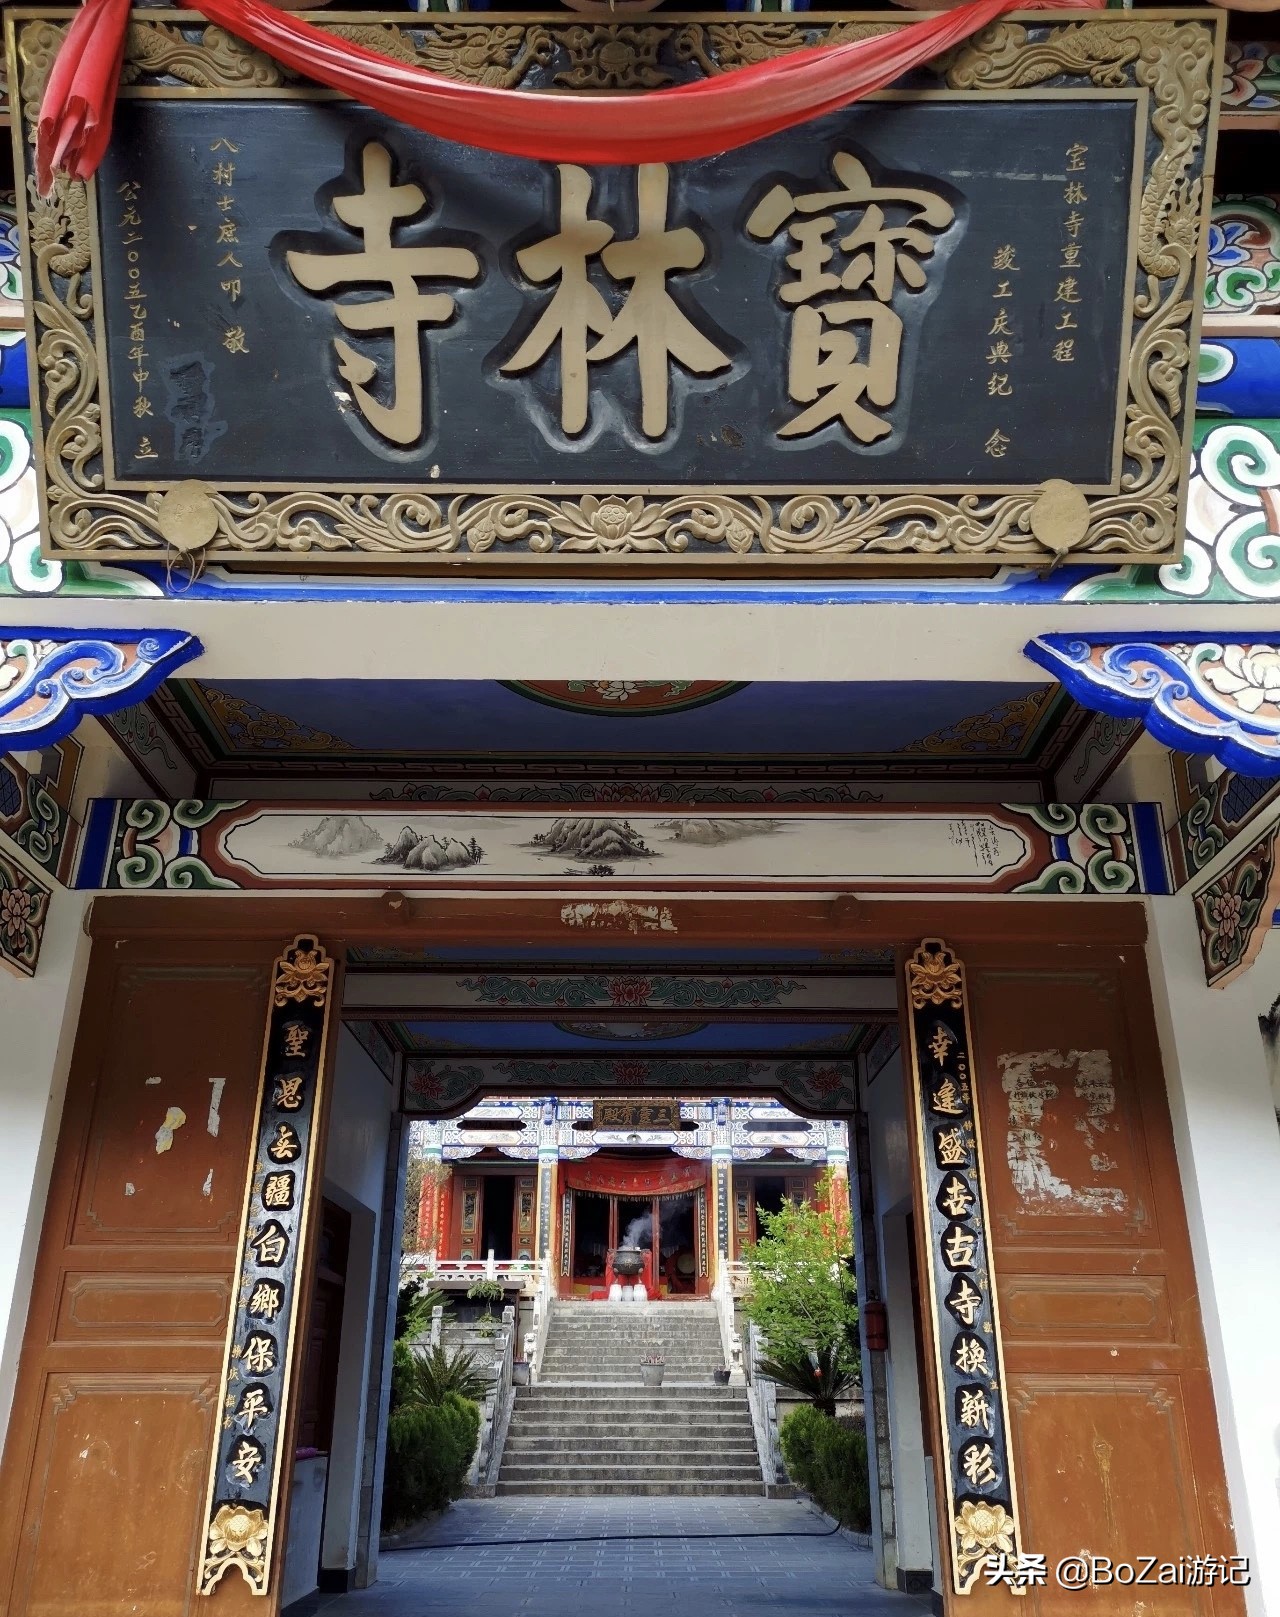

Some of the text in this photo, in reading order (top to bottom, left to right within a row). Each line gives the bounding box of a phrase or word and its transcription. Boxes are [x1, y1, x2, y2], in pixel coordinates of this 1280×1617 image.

[287, 141, 955, 445] 寶林寺
[984, 244, 1020, 457] 竣工庆典纪念
[1051, 143, 1088, 363] 宝林寺重建工程
